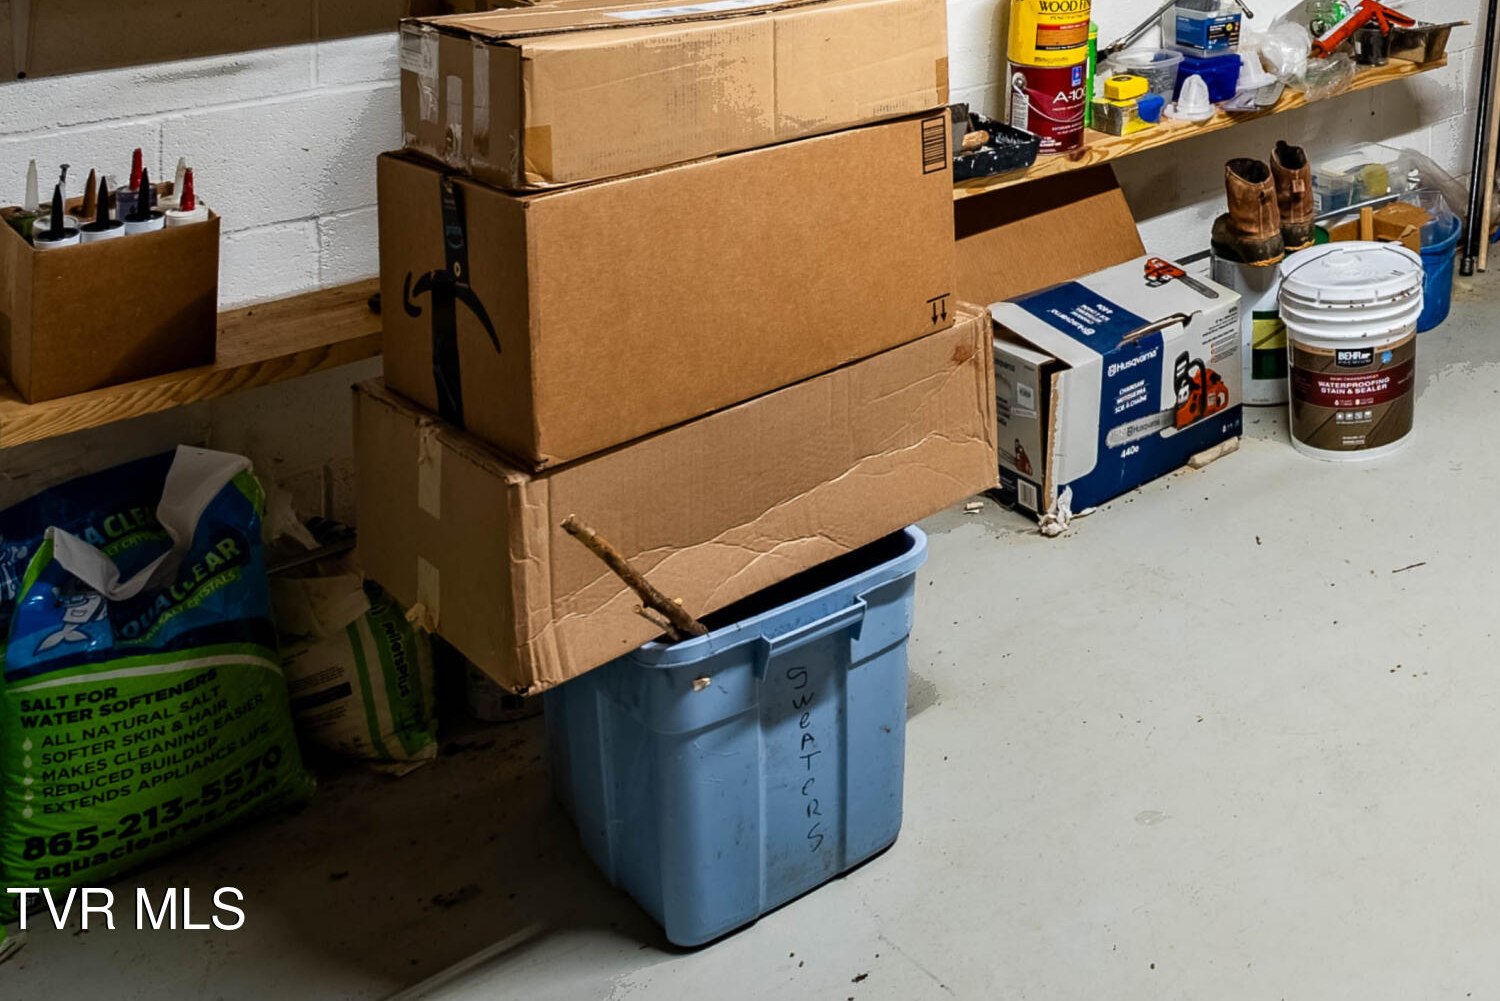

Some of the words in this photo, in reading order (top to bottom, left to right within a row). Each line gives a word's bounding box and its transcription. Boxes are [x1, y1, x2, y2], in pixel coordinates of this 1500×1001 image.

[1039, 0, 1078, 12] WOOD
[1116, 349, 1157, 372] Husqvarna
[1317, 377, 1391, 389] WATERPROOFING
[1338, 351, 1362, 360] BEHR
[1320, 387, 1346, 395] STAIN
[1354, 384, 1388, 394] SEALER
[21, 707, 93, 729] WATER
[99, 667, 217, 717] SOFTENERS
[21, 695, 69, 713] SALT
[74, 686, 118, 706] FOR
[42, 733, 77, 748] ALL
[82, 708, 175, 741] NATURAL
[180, 685, 222, 713] SALT
[42, 739, 116, 765] SOFTER
[122, 722, 166, 747] SKIN
[171, 720, 183, 731] &
[188, 699, 229, 726] HAIR
[42, 755, 108, 782] MAKES
[114, 725, 209, 765] CLEANING
[213, 693, 264, 731] EASIER
[43, 768, 134, 798] REDUCED
[141, 736, 219, 775] BUILDUP
[43, 787, 131, 814] EXTENDS
[137, 742, 237, 792] APPLIANCE
[240, 721, 269, 747] LIFE
[23, 745, 282, 860] 865-213-5570
[34, 775, 278, 880] aquaclearws.com
